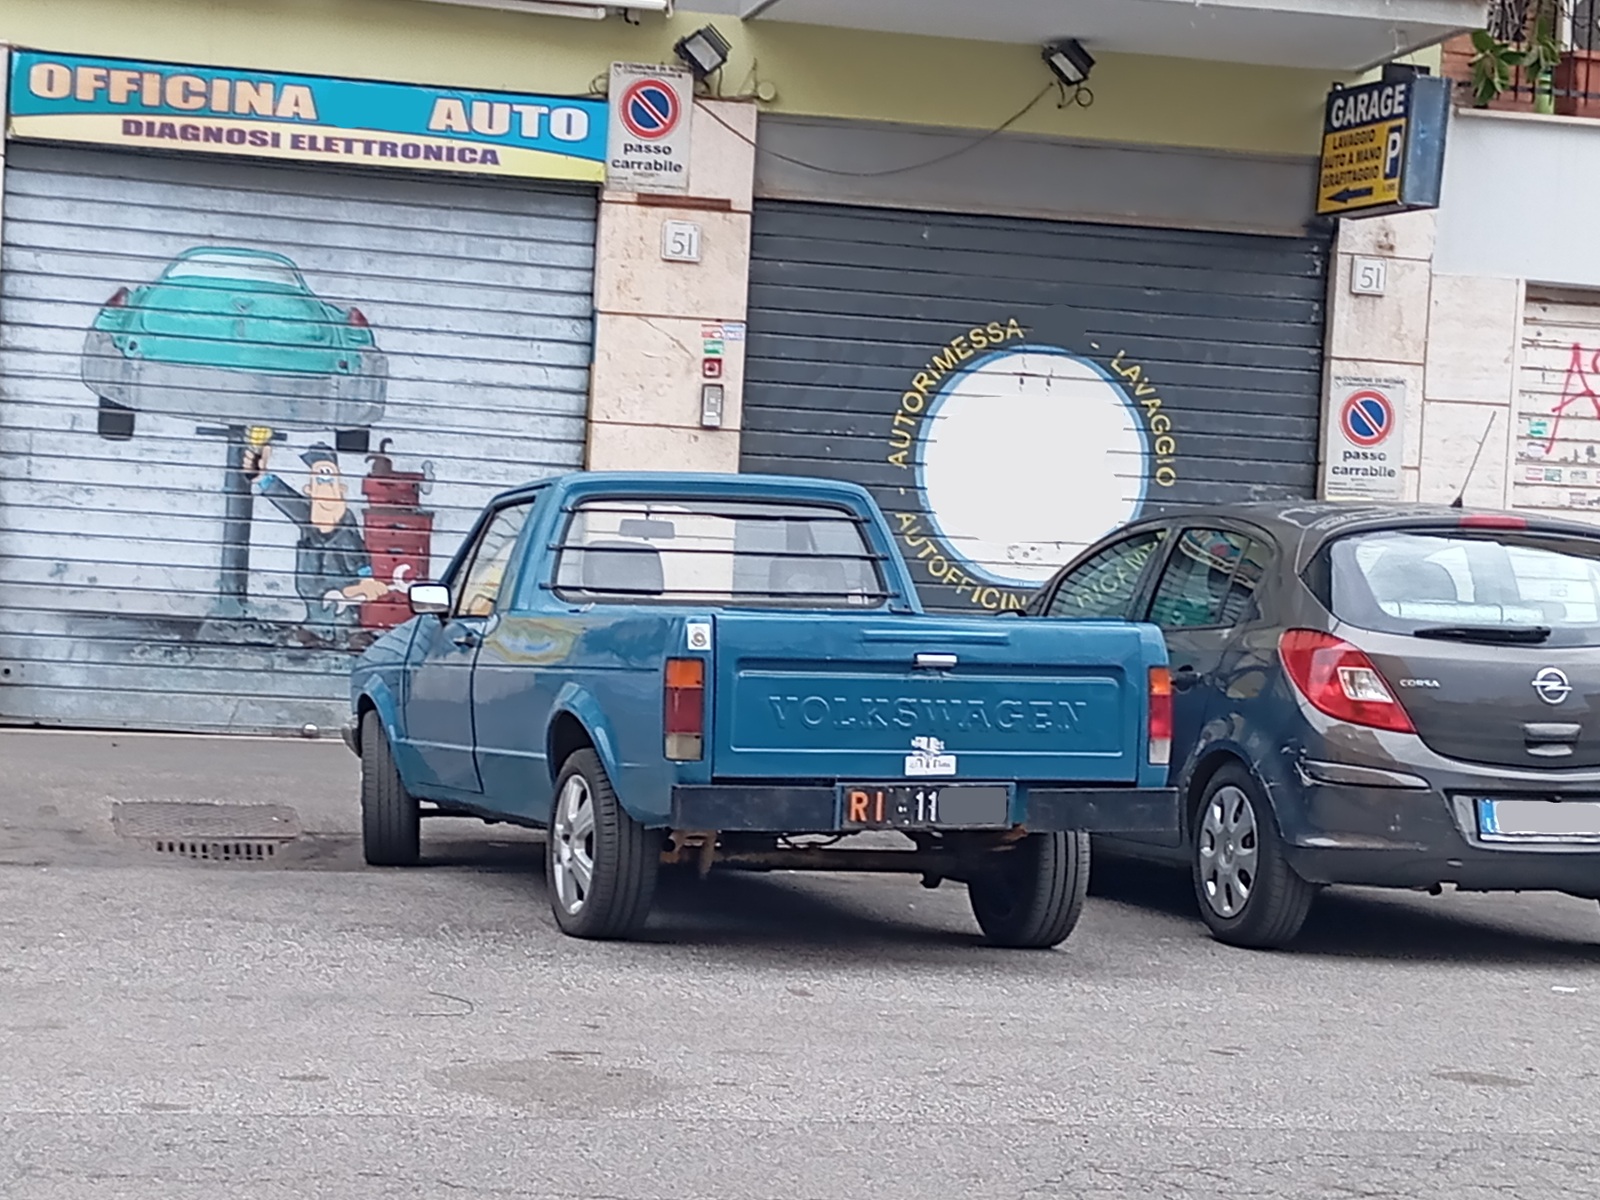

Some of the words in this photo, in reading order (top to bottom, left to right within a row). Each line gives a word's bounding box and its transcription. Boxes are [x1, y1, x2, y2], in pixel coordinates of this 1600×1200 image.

[29, 62, 318, 122] OFFICINA
[427, 97, 590, 142] AUTO
[1331, 83, 1406, 129] GARAGE
[121, 118, 281, 149] DIAGNOSI
[289, 132, 500, 167] ELETTRONICA
[623, 142, 672, 156] passo
[1332, 129, 1376, 151] LAVAGGIO
[1385, 131, 1401, 175] P
[611, 158, 683, 173] carrabile
[671, 231, 693, 256] 51
[1360, 266, 1382, 290] 51
[888, 318, 1025, 470] AUTORIMESSA
[1110, 349, 1177, 488] LAVAGGIO
[1331, 465, 1396, 478] carrabile
[1342, 450, 1387, 462] passo
[894, 513, 1027, 610] AUTOFFICIN
[768, 695, 1087, 733] VOLKSWAGEN
[849, 790, 884, 822] RI
